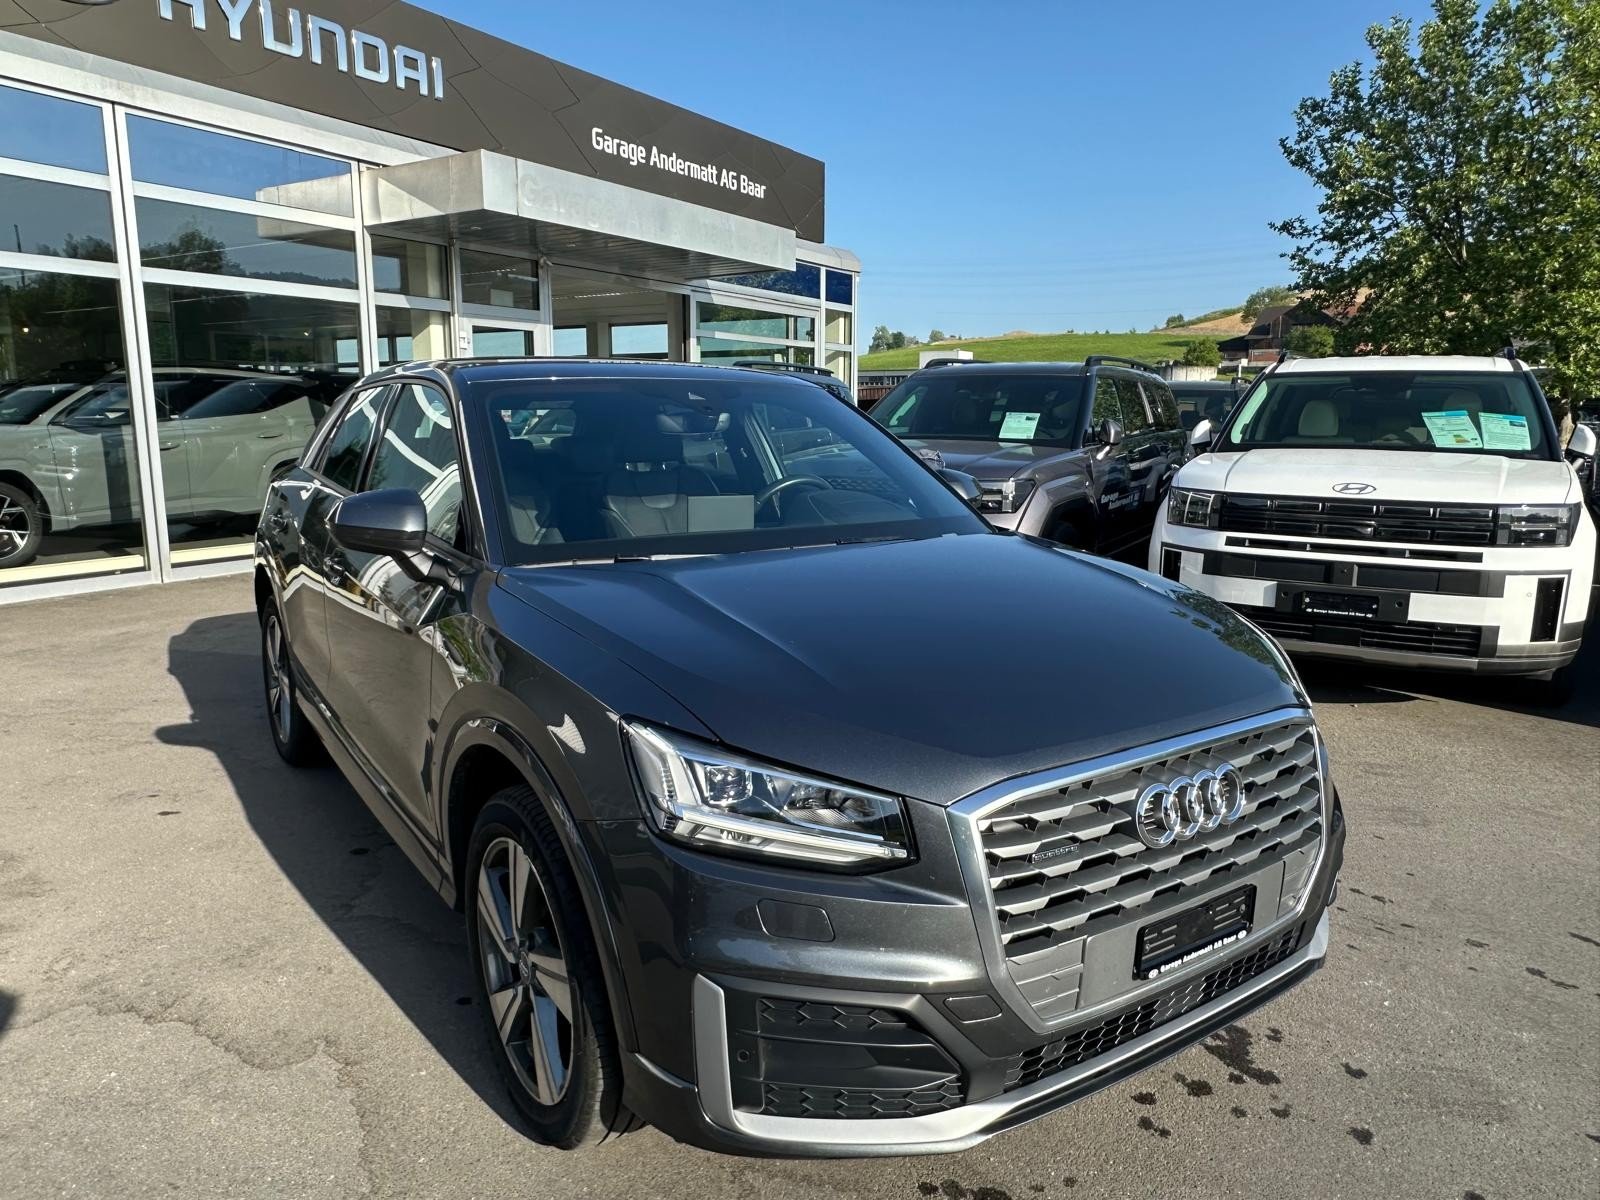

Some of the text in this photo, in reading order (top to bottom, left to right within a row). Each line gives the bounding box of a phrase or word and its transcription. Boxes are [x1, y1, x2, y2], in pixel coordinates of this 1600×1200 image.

[591, 127, 766, 199] Garage Andermatt AG Baar
